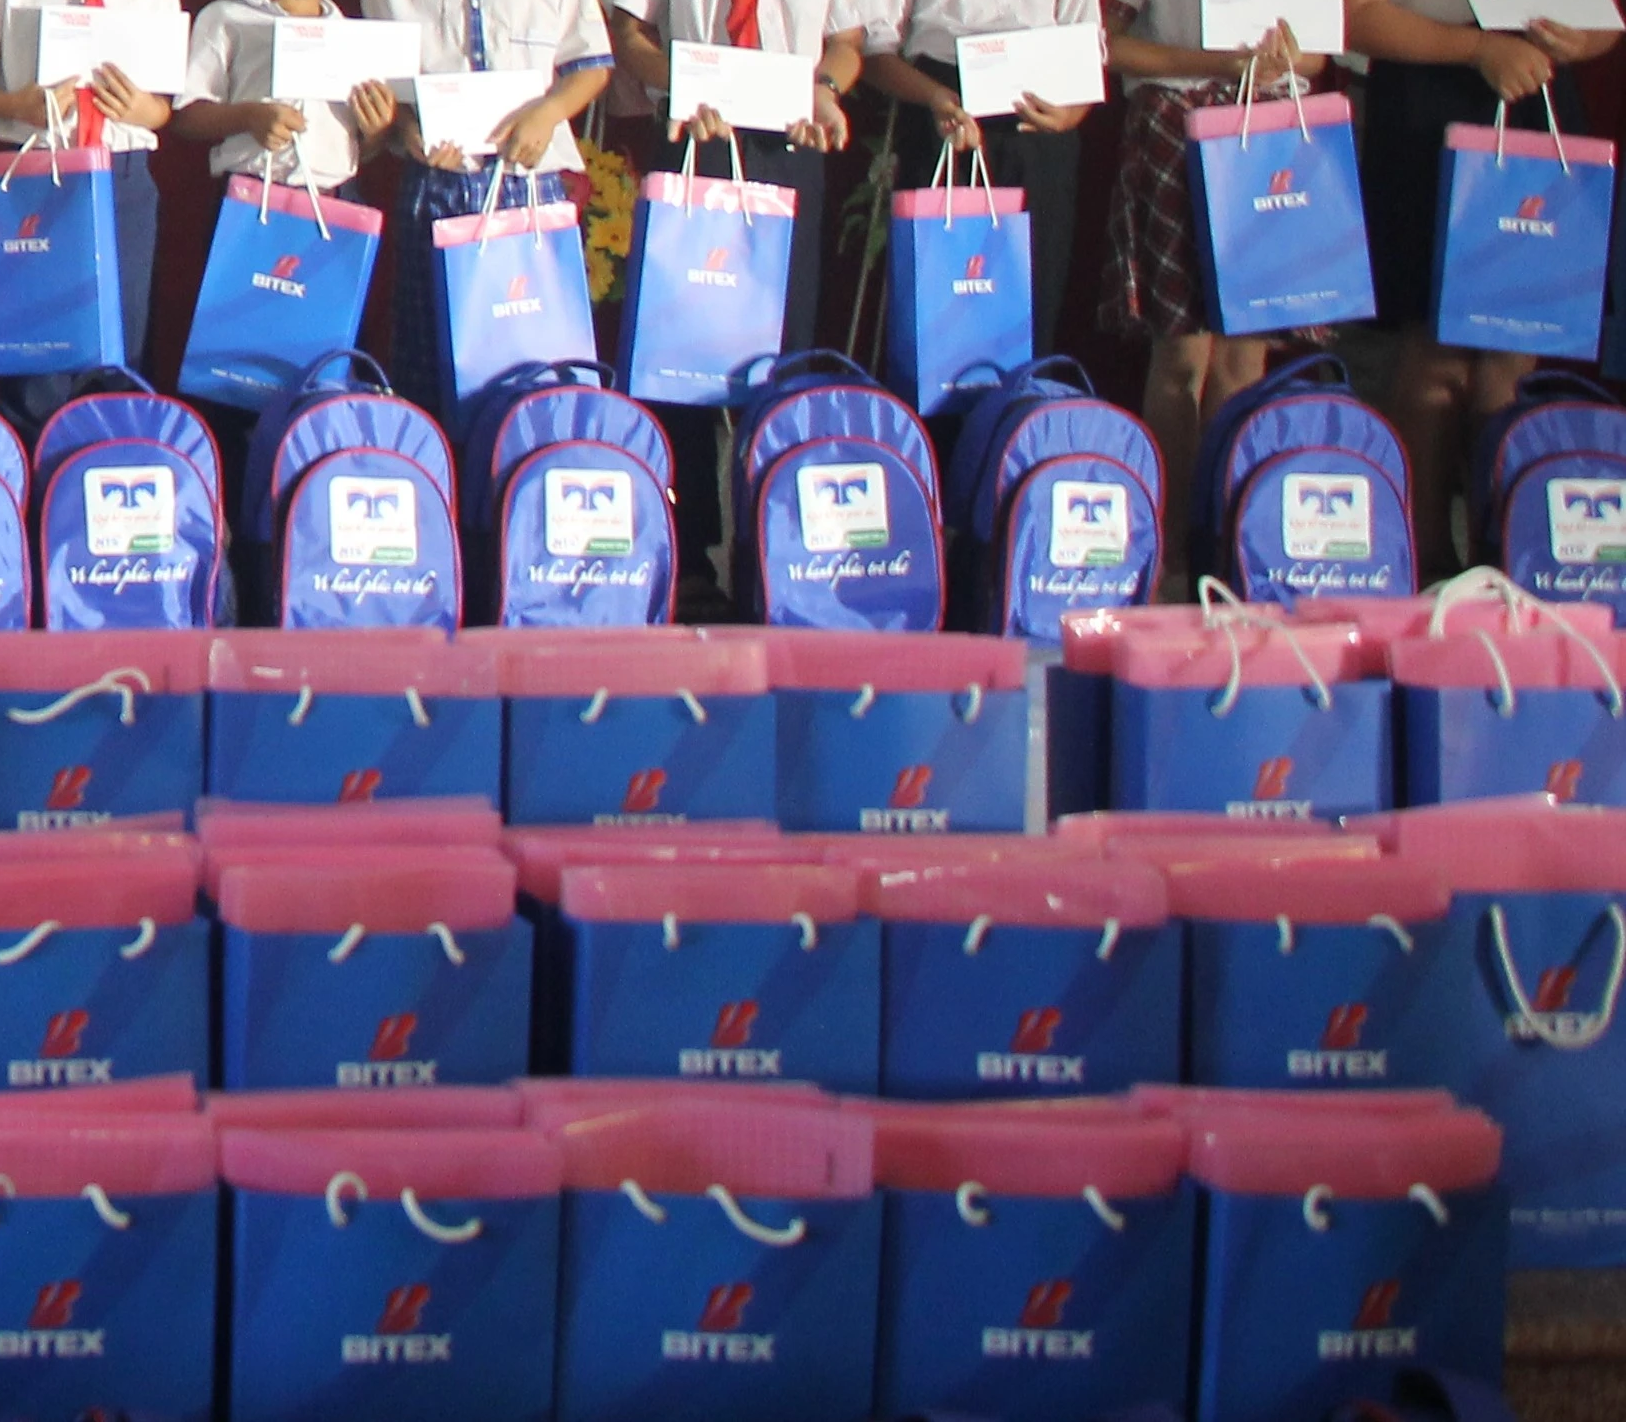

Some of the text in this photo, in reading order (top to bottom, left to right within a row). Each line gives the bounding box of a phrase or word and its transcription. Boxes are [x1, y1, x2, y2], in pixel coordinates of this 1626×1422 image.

[1254, 192, 1309, 211] BITEX
[1499, 217, 1555, 236] BITEX
[4, 239, 49, 253] BITEX
[253, 273, 306, 297] BITEX
[688, 270, 737, 287] BITEX
[954, 279, 993, 294] BITEX
[493, 298, 542, 317] BITEX
[862, 810, 948, 830] BITEX
[9, 1060, 112, 1084] BITEX
[680, 1050, 778, 1073] BITEX
[978, 1054, 1082, 1080] BITEX
[1288, 1051, 1385, 1076] BITEX
[338, 1063, 435, 1085] BITEX
[343, 1335, 449, 1362] BITEX
[663, 1332, 773, 1361] BITEX
[983, 1329, 1091, 1357] BITEX
[1319, 1330, 1414, 1358] BITEX
